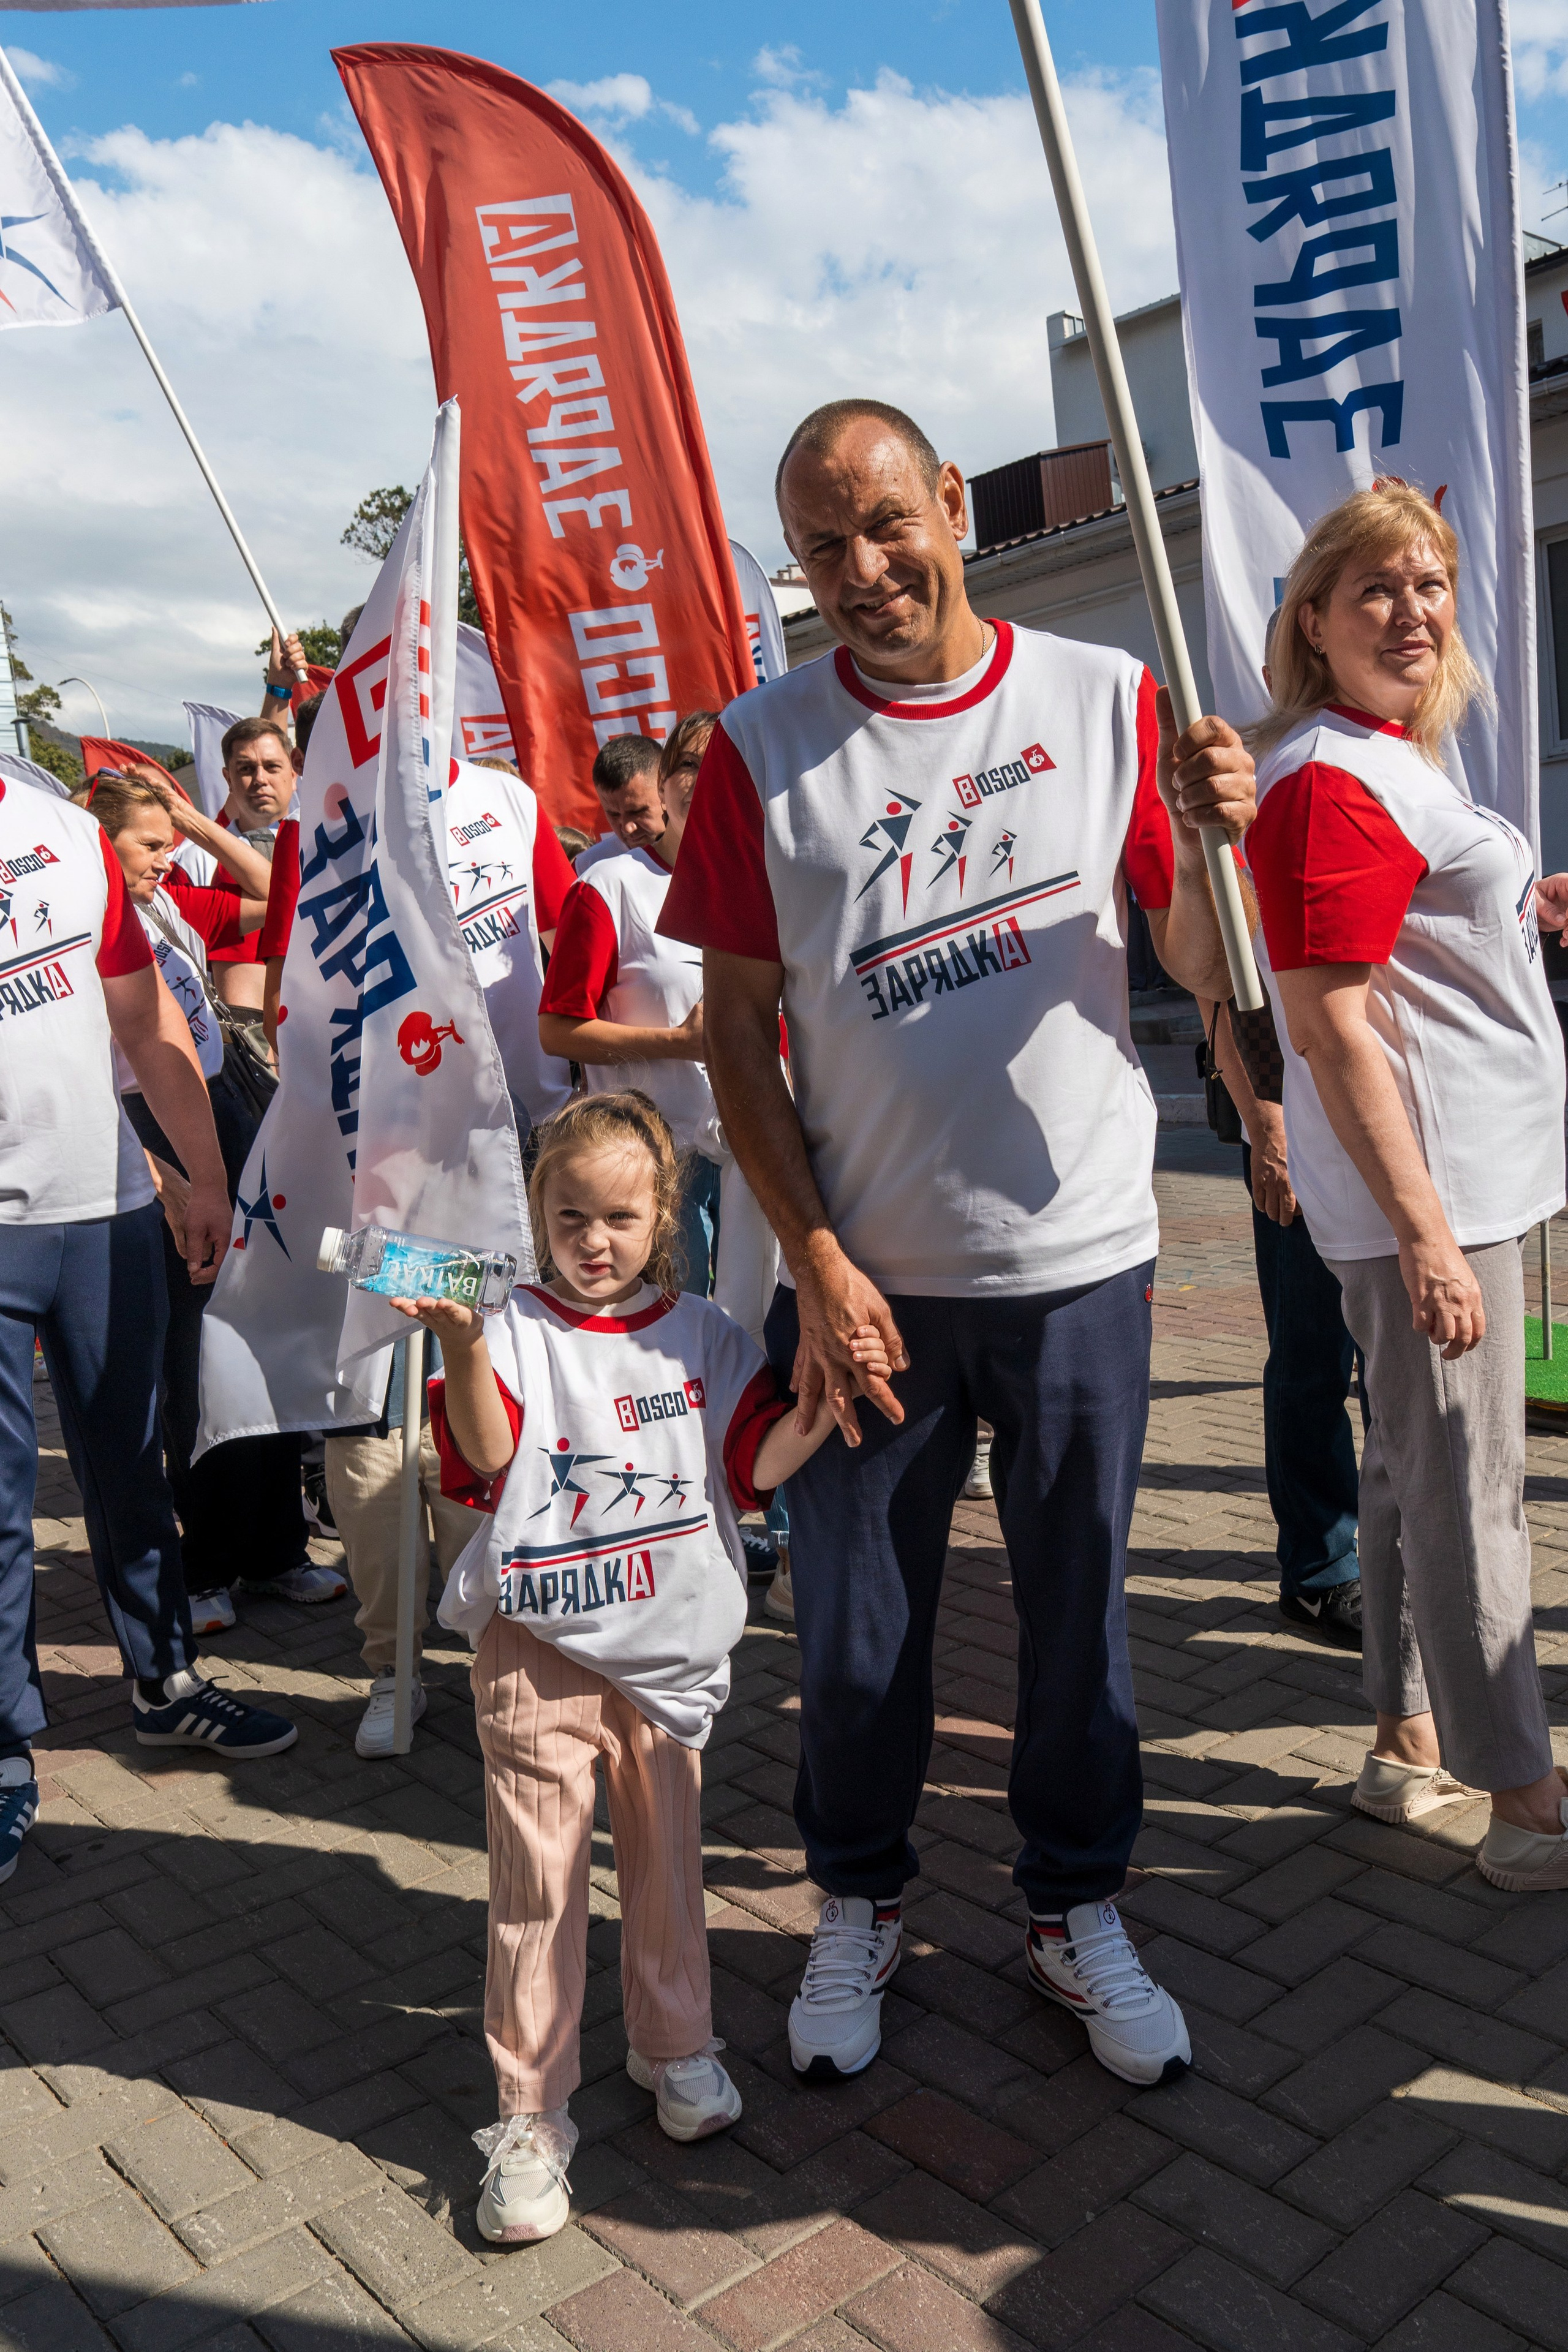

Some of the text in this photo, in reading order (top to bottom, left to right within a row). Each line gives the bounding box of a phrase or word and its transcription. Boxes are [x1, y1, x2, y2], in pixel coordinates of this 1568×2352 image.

[952, 760, 1031, 809] BOSCO
[450, 820, 492, 846] BOSCO
[462, 907, 521, 954] ЯДКА
[0, 962, 74, 1022] ЯДКА
[861, 916, 1032, 1021] ЗАРЯДКА
[388, 1261, 478, 1297] BAIKAL
[614, 1390, 688, 1432] BOSCO
[499, 1550, 655, 1616] ЗАРЯДКА
